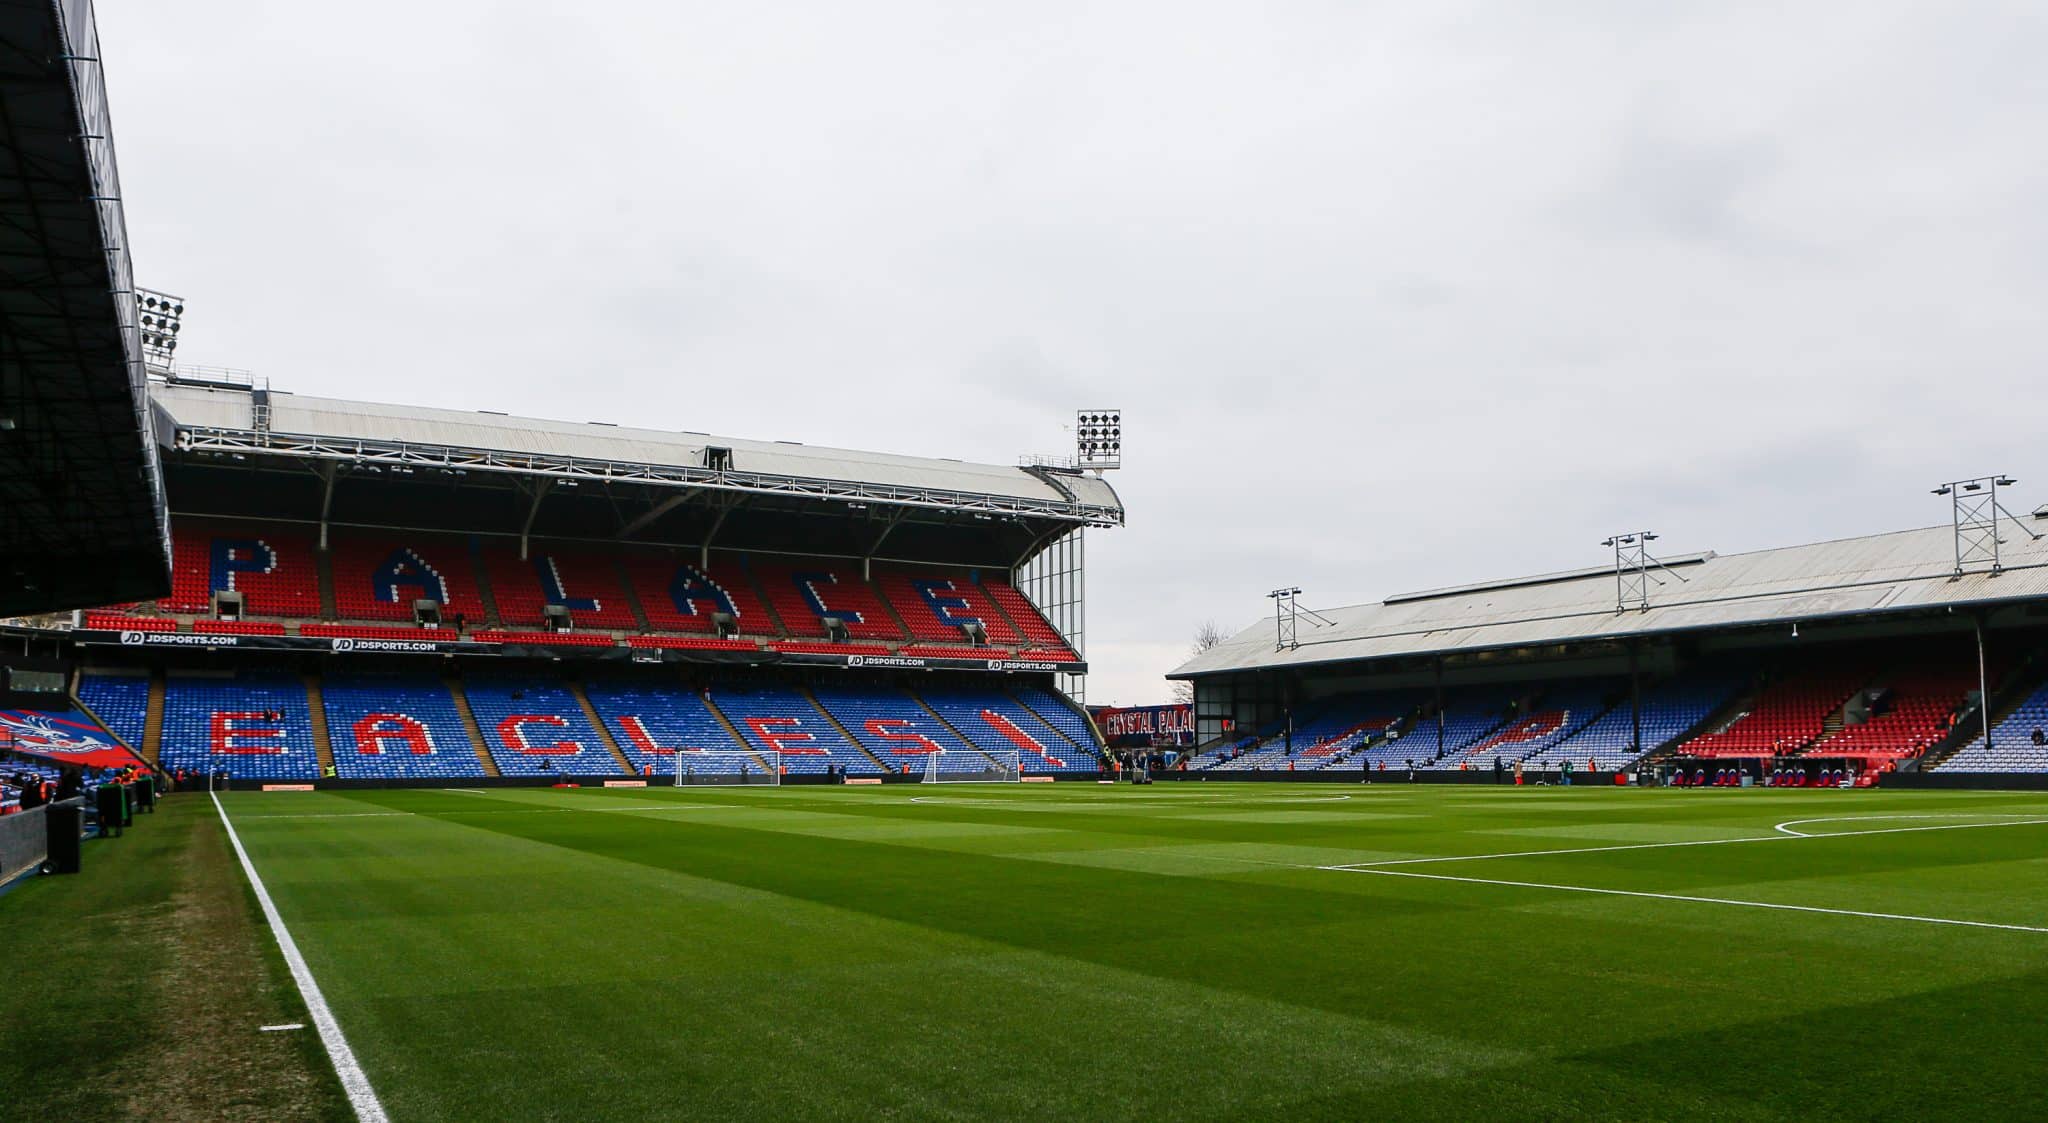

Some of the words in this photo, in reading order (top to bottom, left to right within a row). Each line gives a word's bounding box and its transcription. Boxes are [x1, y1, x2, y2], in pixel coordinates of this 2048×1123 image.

[210, 538, 987, 629] PALACE
[145, 634, 238, 645] JDSPORTS.COM
[355, 641, 436, 651] JDSPORTS.COM
[864, 657, 925, 666] JDSPORTS.COM
[1003, 663, 1057, 671] JDSPORTS.COM
[1106, 711, 1156, 735] CRYSTAL
